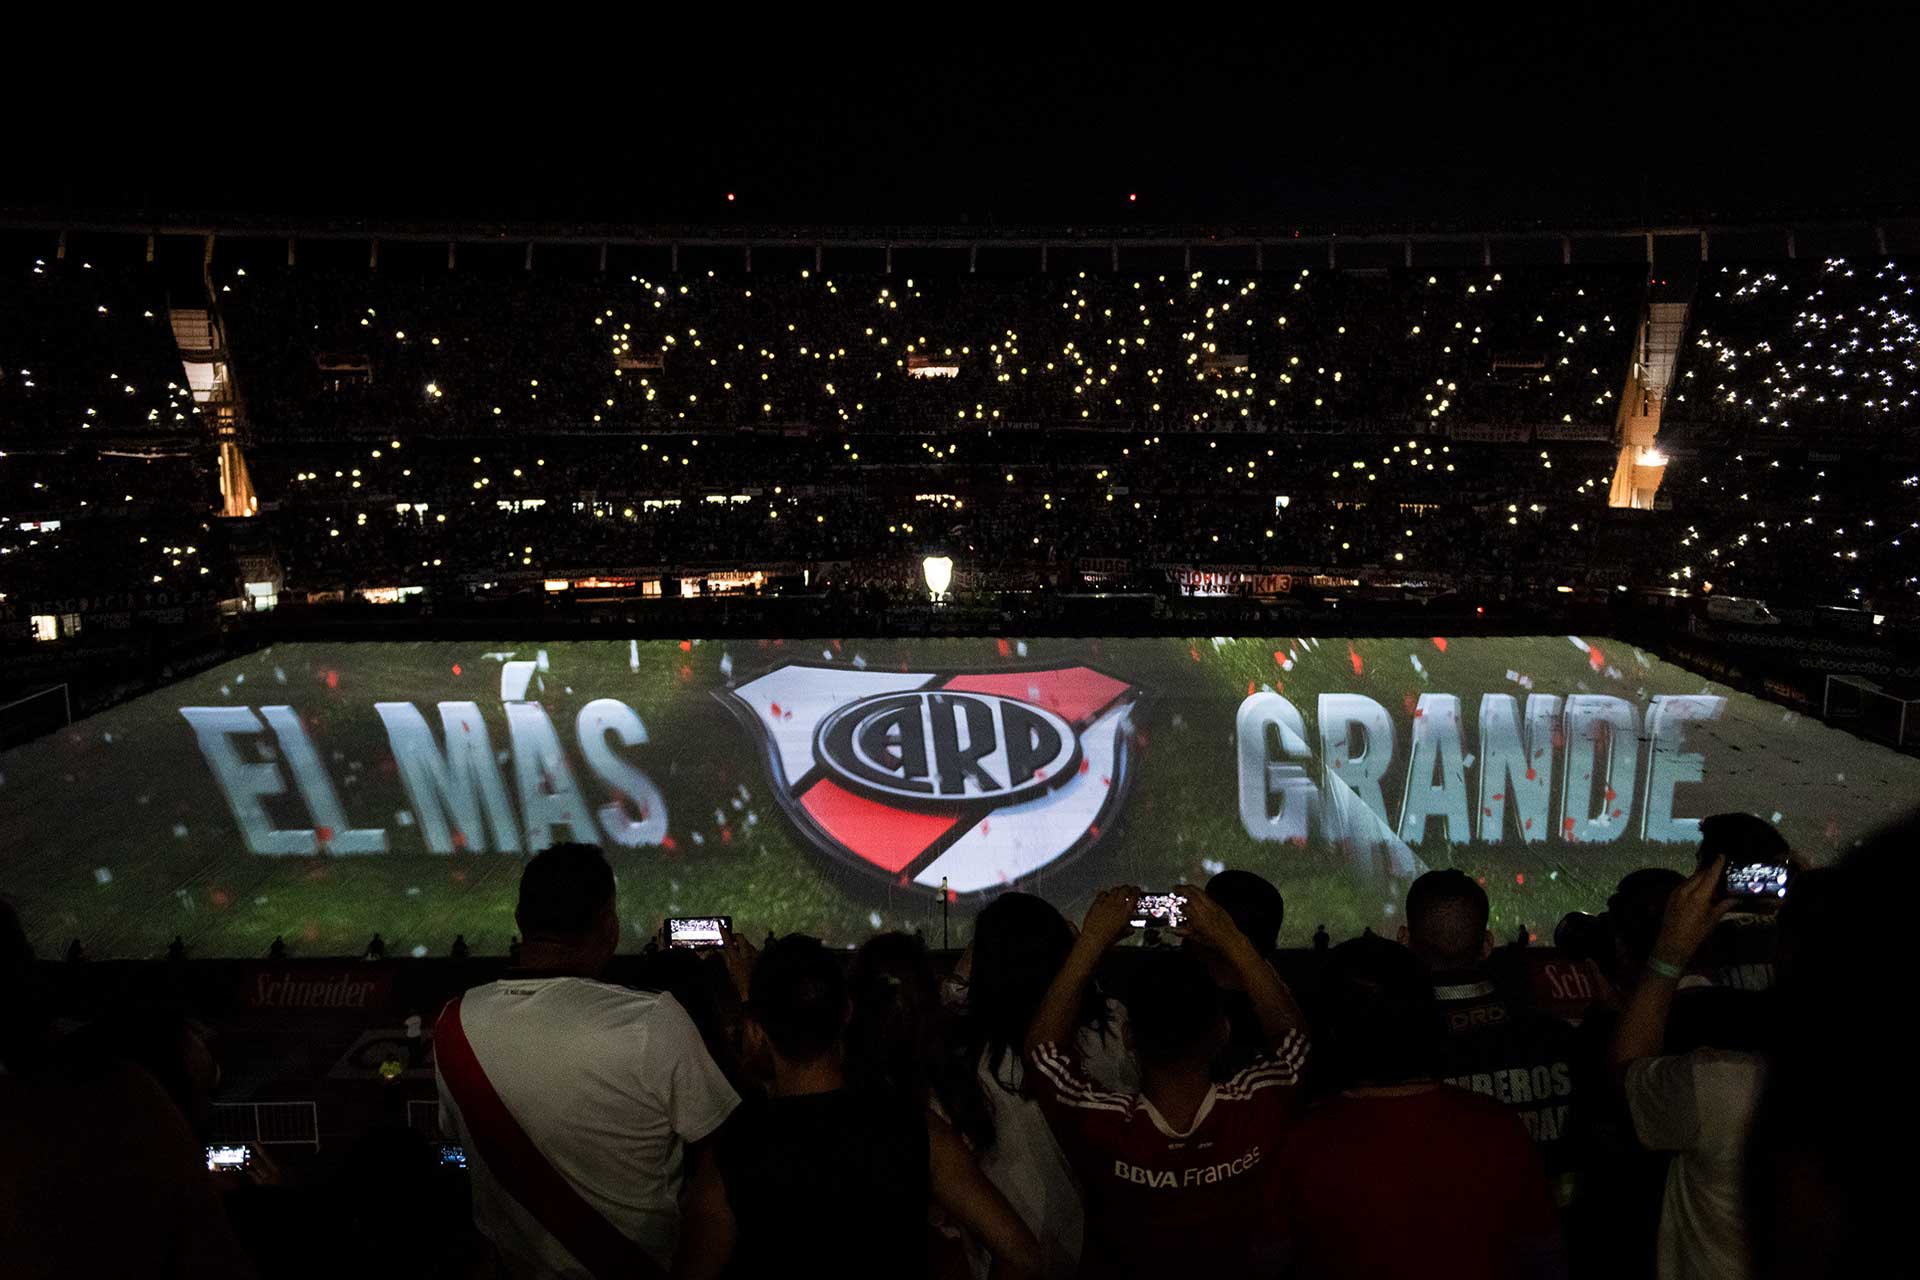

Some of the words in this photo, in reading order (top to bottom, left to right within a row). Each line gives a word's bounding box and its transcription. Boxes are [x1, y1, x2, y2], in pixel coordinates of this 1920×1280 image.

[178, 704, 390, 856] EL
[373, 660, 670, 853] MÁS
[1236, 691, 1728, 845] GRANDE
[250, 971, 376, 1007] Schneider
[1113, 1159, 1179, 1189] BBVA
